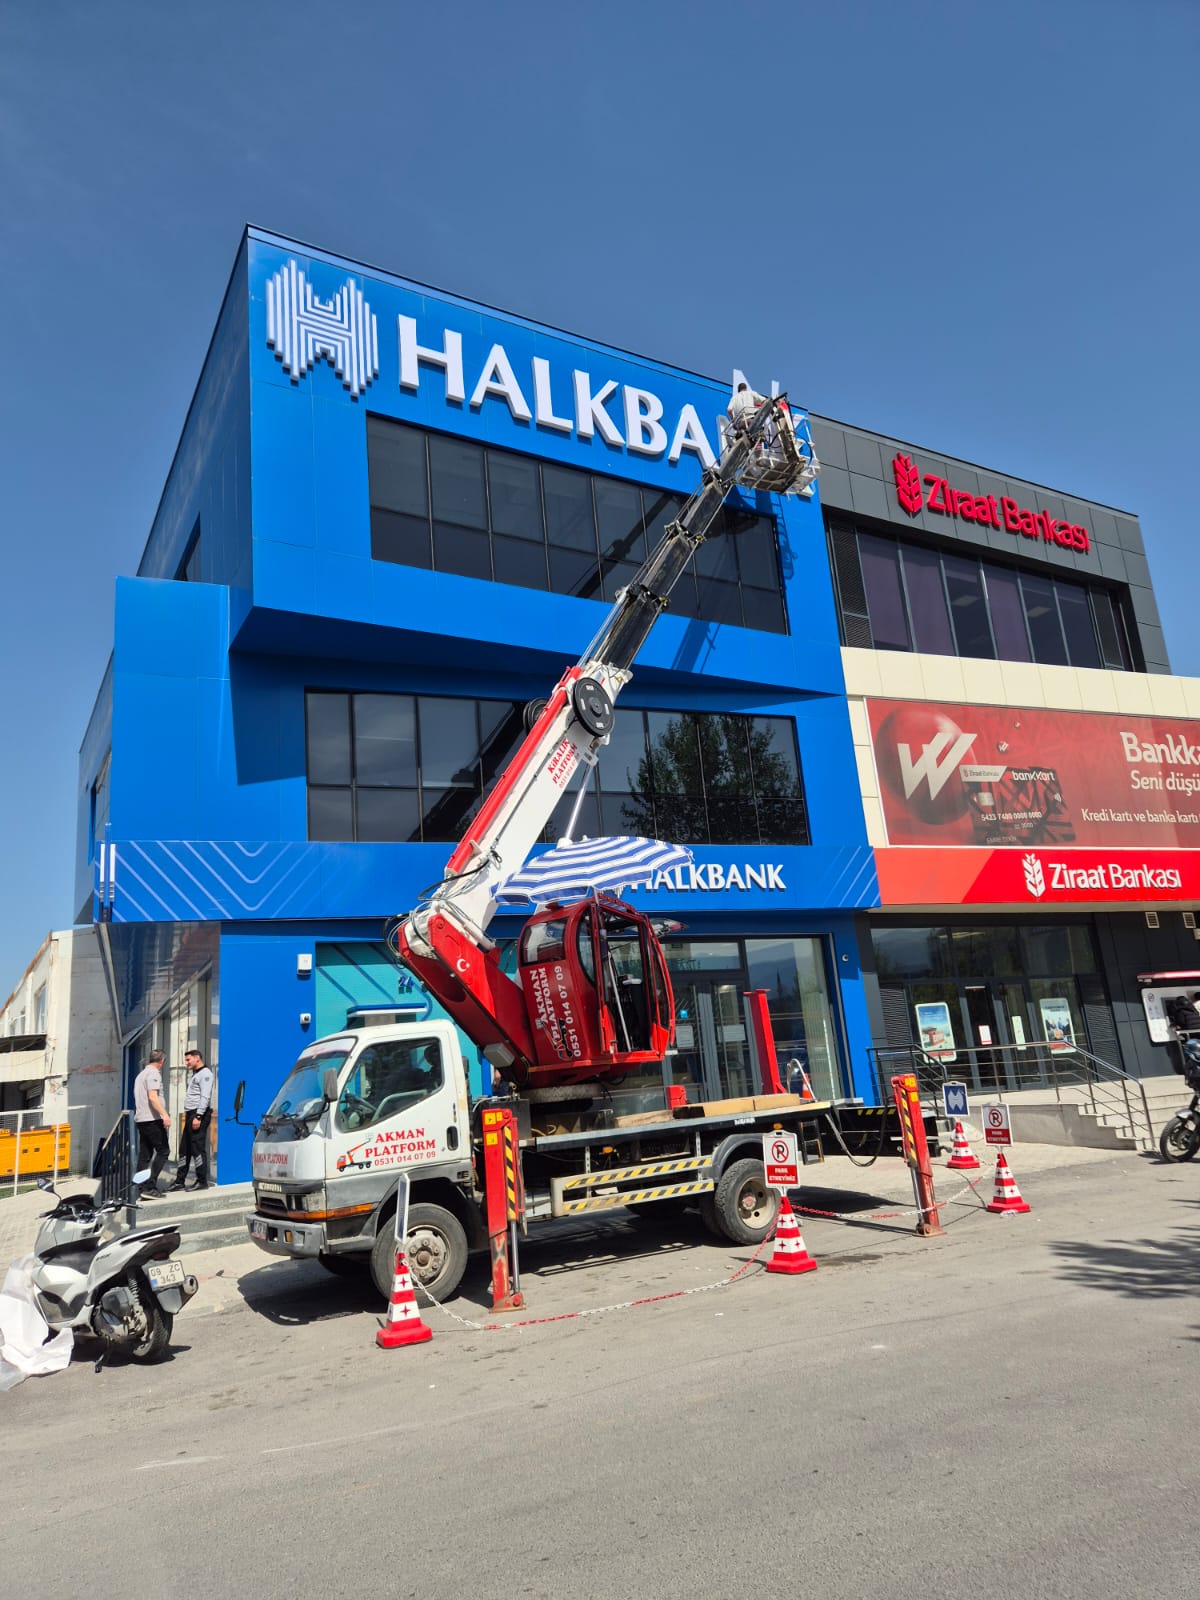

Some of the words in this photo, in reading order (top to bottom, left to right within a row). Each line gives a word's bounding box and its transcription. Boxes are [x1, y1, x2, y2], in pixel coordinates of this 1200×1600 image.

[923, 473, 1002, 530] Ziraat
[1000, 495, 1091, 553] Bankası
[552, 743, 577, 785] PLATFORM
[1130, 770, 1163, 791] Seni
[1081, 808, 1109, 822] Kredi
[1133, 812, 1146, 823] ve
[1146, 809, 1177, 824] banka
[630, 863, 787, 890] ALKBANK
[1048, 863, 1109, 889] Ziraat
[1108, 863, 1182, 889] Bankası
[554, 965, 564, 981] 09
[530, 970, 548, 1024] AKMAN
[557, 984, 568, 999] 07
[538, 967, 561, 1043] PLATFORM
[562, 1001, 574, 1025] 014
[568, 1028, 582, 1057] 0531
[375, 1127, 425, 1144] AKMAN
[365, 1139, 436, 1158] PLATFORM
[374, 1158, 394, 1166] 0531
[397, 1154, 412, 1163] 014
[414, 1152, 424, 1161] 07
[426, 1150, 436, 1159] 09
